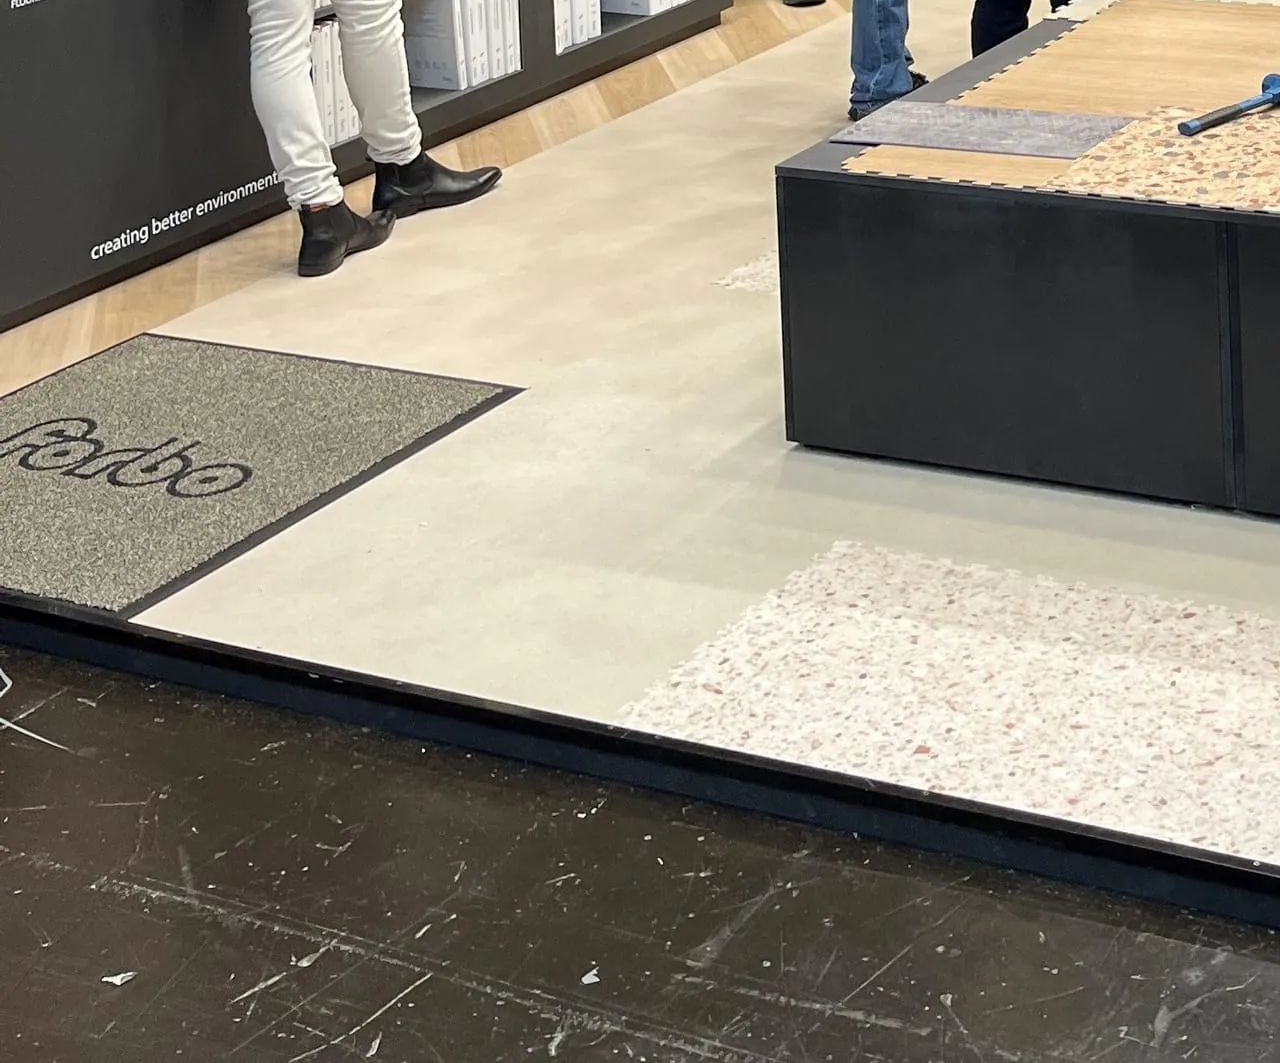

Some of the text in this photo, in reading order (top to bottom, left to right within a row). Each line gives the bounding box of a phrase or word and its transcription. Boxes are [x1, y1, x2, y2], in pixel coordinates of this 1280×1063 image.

[90, 170, 281, 260] creating better environment
